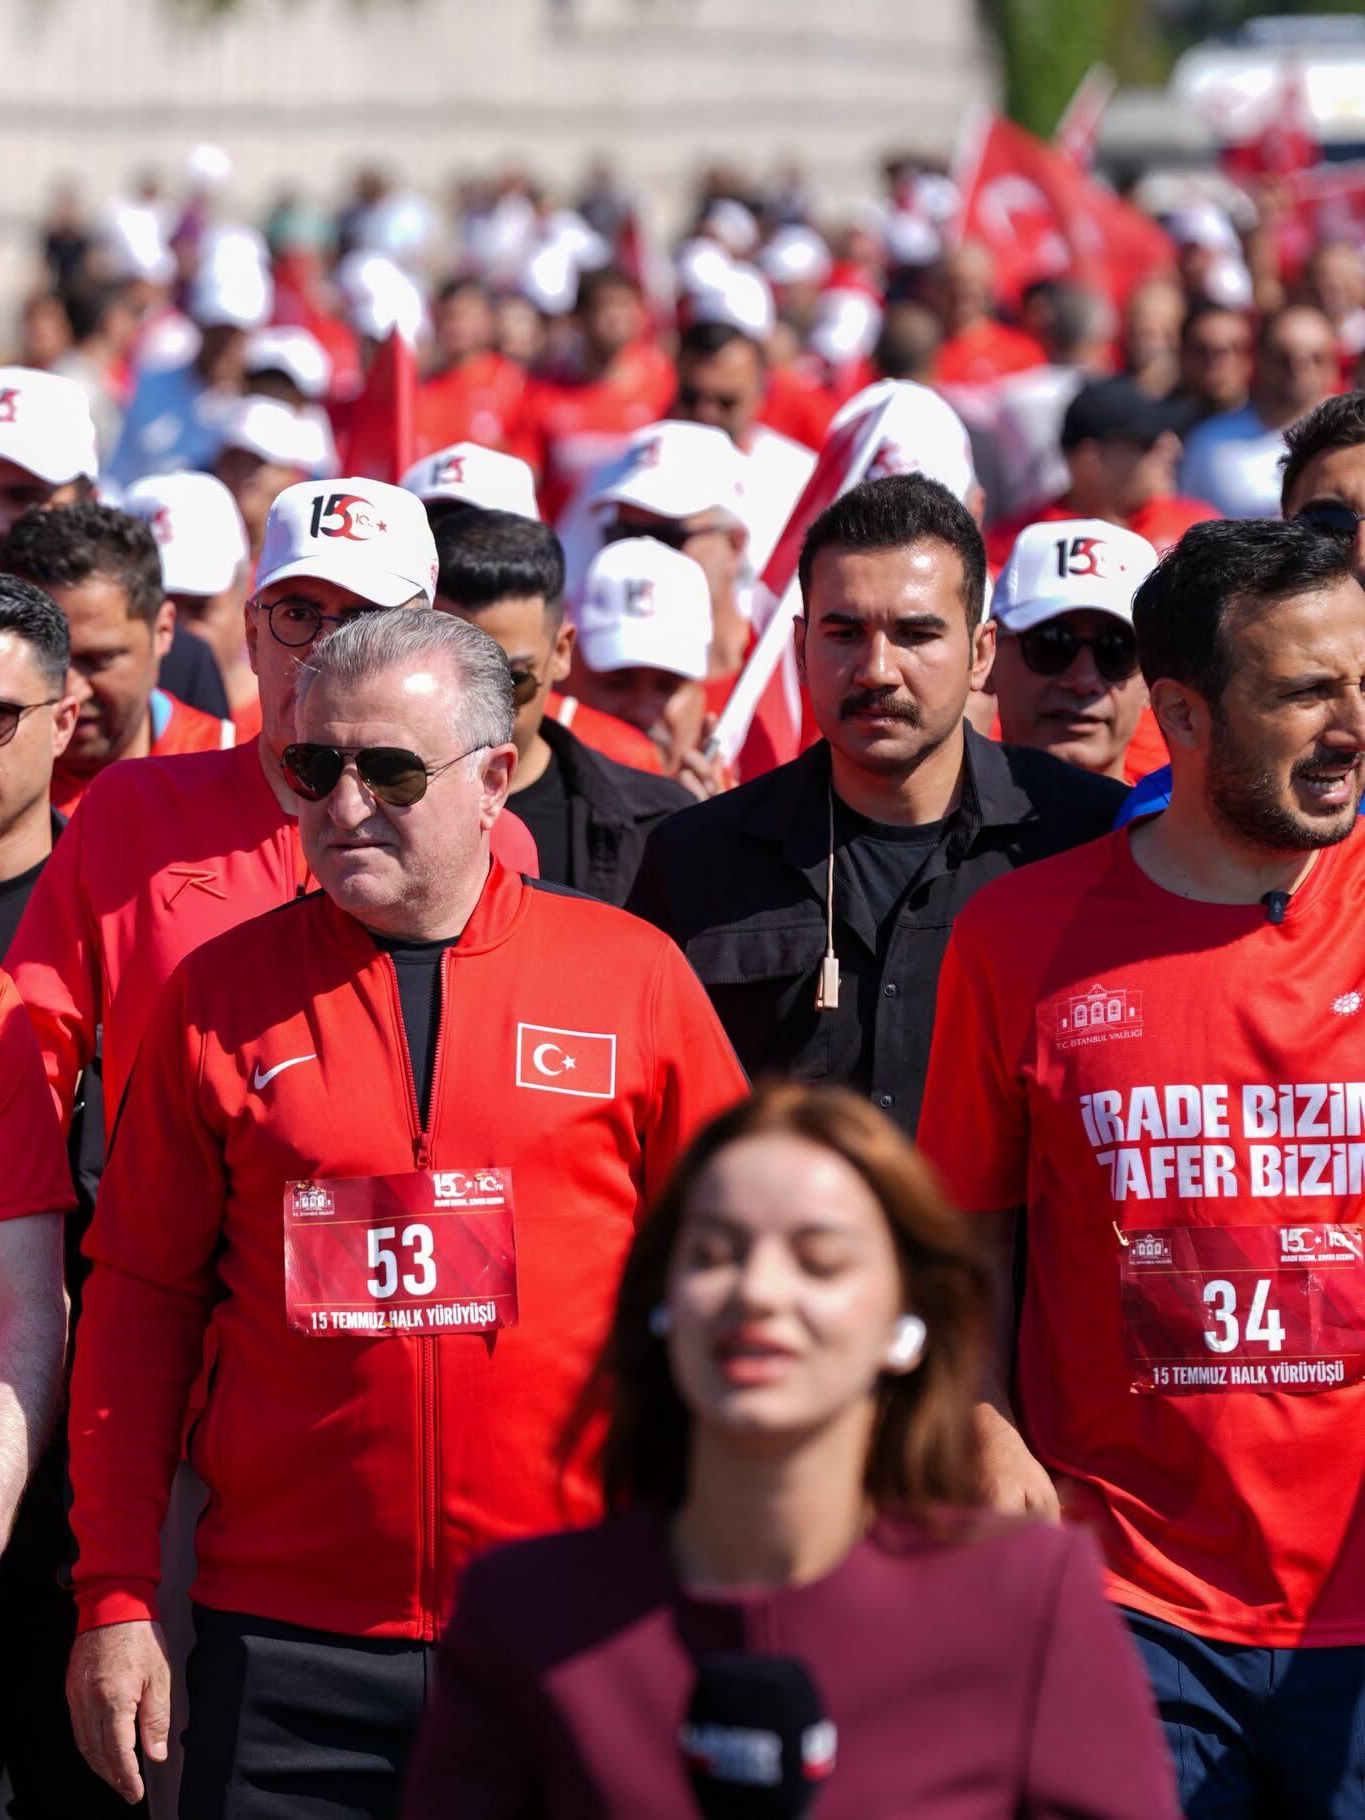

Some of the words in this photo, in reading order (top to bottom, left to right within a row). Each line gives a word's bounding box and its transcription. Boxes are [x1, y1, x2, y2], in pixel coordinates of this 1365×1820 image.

[310, 493, 367, 540] 15
[1055, 537, 1105, 579] 15
[367, 1223, 437, 1298] 53
[1280, 1228, 1310, 1253] 15
[311, 1311, 328, 1330] 15
[330, 1310, 385, 1329] TEMMUZ
[389, 1308, 423, 1328] HALK
[426, 1303, 496, 1327] YÜRÜYÜŞÜ
[1203, 1279, 1285, 1353] 34
[1153, 1367, 1169, 1385] 15
[1173, 1365, 1228, 1385] TEMMUZ
[1231, 1362, 1268, 1385] HALK
[1271, 1360, 1345, 1386] YÜRÜYÜŞÜ
